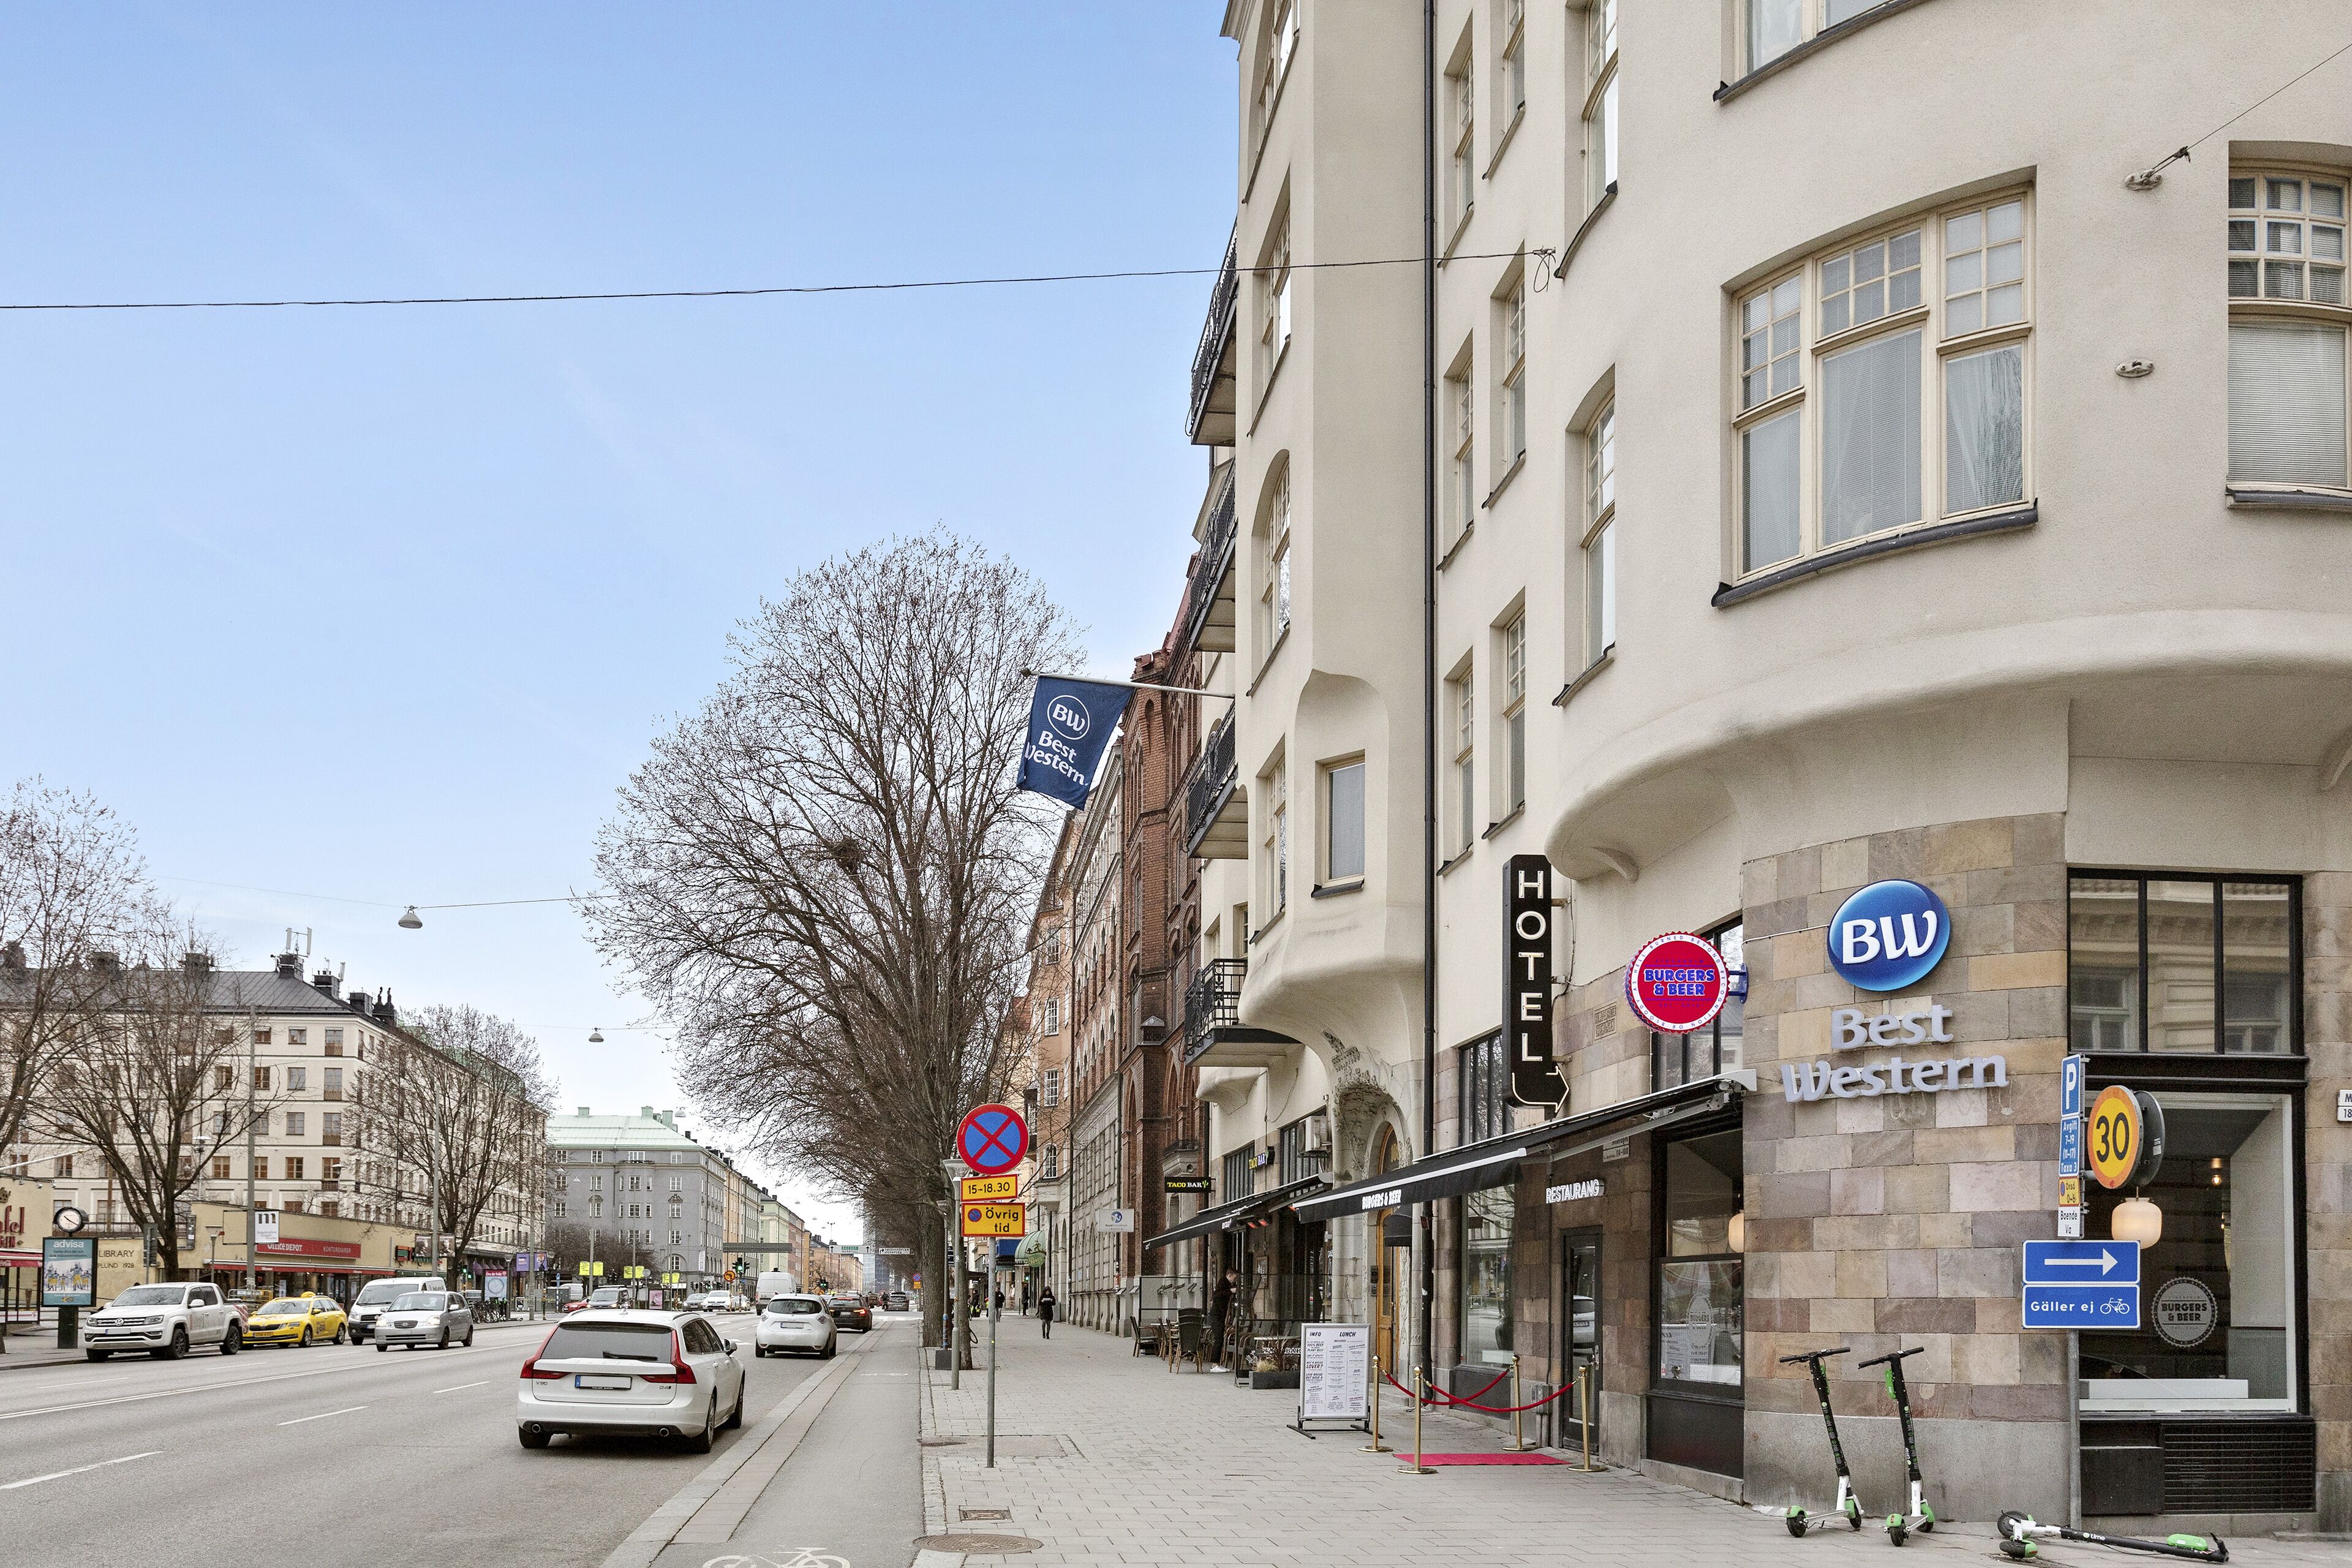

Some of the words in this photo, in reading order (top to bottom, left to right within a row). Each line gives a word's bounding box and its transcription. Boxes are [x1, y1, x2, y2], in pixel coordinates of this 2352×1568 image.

[1052, 703, 1085, 731] BW
[1038, 730, 1077, 763] Best
[1649, 935, 1684, 949] BURNED
[1842, 910, 1938, 965] BW
[1691, 937, 1721, 964] BEYOND
[1516, 870, 1547, 1061] HOTEL
[1634, 954, 1646, 974] HELL
[1644, 968, 1715, 982] BURGERS
[1654, 983, 1664, 996] &
[1668, 983, 1705, 997] BEER
[1691, 970, 1726, 1027] RECOGNITION
[1636, 999, 1665, 1026] BLOODY
[1831, 1005, 1953, 1050] Best
[1781, 1055, 2009, 1102] Western
[2066, 1063, 2076, 1110] P
[2063, 1121, 2077, 1133] Avgift
[2065, 1134, 2075, 1145] 7-19
[2096, 1112, 2130, 1163] 30
[2062, 1148, 2076, 1159] (11-17)
[1248, 1156, 1257, 1169] TACO
[2060, 1163, 2073, 1173] Taxa
[2074, 1162, 2077, 1172] 3
[968, 1182, 1010, 1194] 15-18.30
[1546, 1179, 1599, 1204] RESTAURANG
[2066, 1182, 2076, 1191] Onsd
[1362, 1192, 1384, 1210] BURGERS
[1384, 1191, 1389, 1206] &
[1389, 1189, 1402, 1205] BEER
[986, 1207, 1019, 1222] Övrig
[2060, 1211, 2078, 1221] Boende
[994, 1223, 1010, 1233] tid
[2030, 1301, 2075, 1311] Gäller
[2081, 1301, 2094, 1314] ej
[2161, 1303, 2207, 1311] BURGERS
